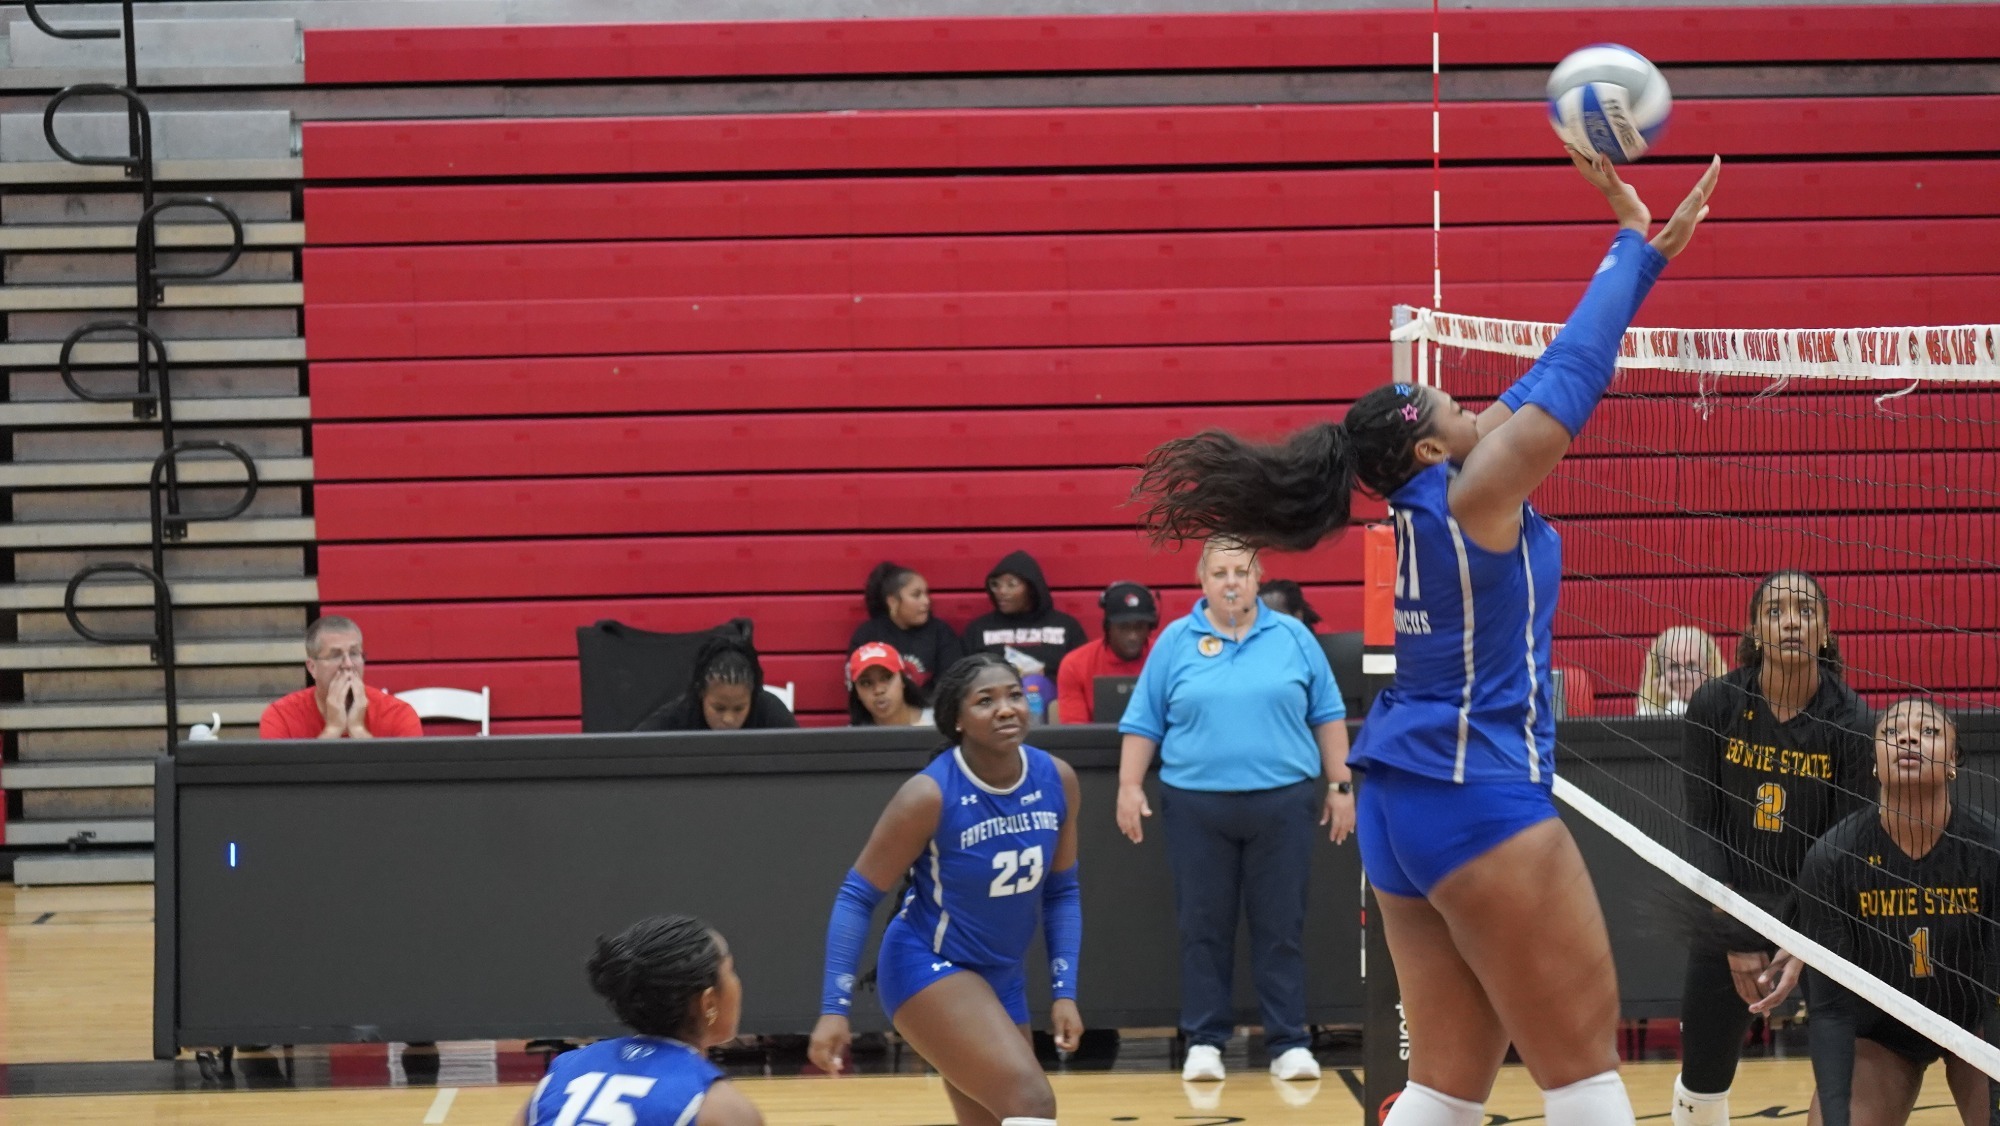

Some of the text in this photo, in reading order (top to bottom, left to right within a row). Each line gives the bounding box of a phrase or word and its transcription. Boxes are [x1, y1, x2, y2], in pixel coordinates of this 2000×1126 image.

[1779, 749, 1833, 779] STATE
[1030, 811, 1059, 831] STATE
[1754, 782, 1786, 833] 2
[988, 845, 1044, 898] 23
[1923, 887, 1980, 915] STATE
[1909, 926, 1935, 979] 1
[552, 1071, 659, 1126] 15
